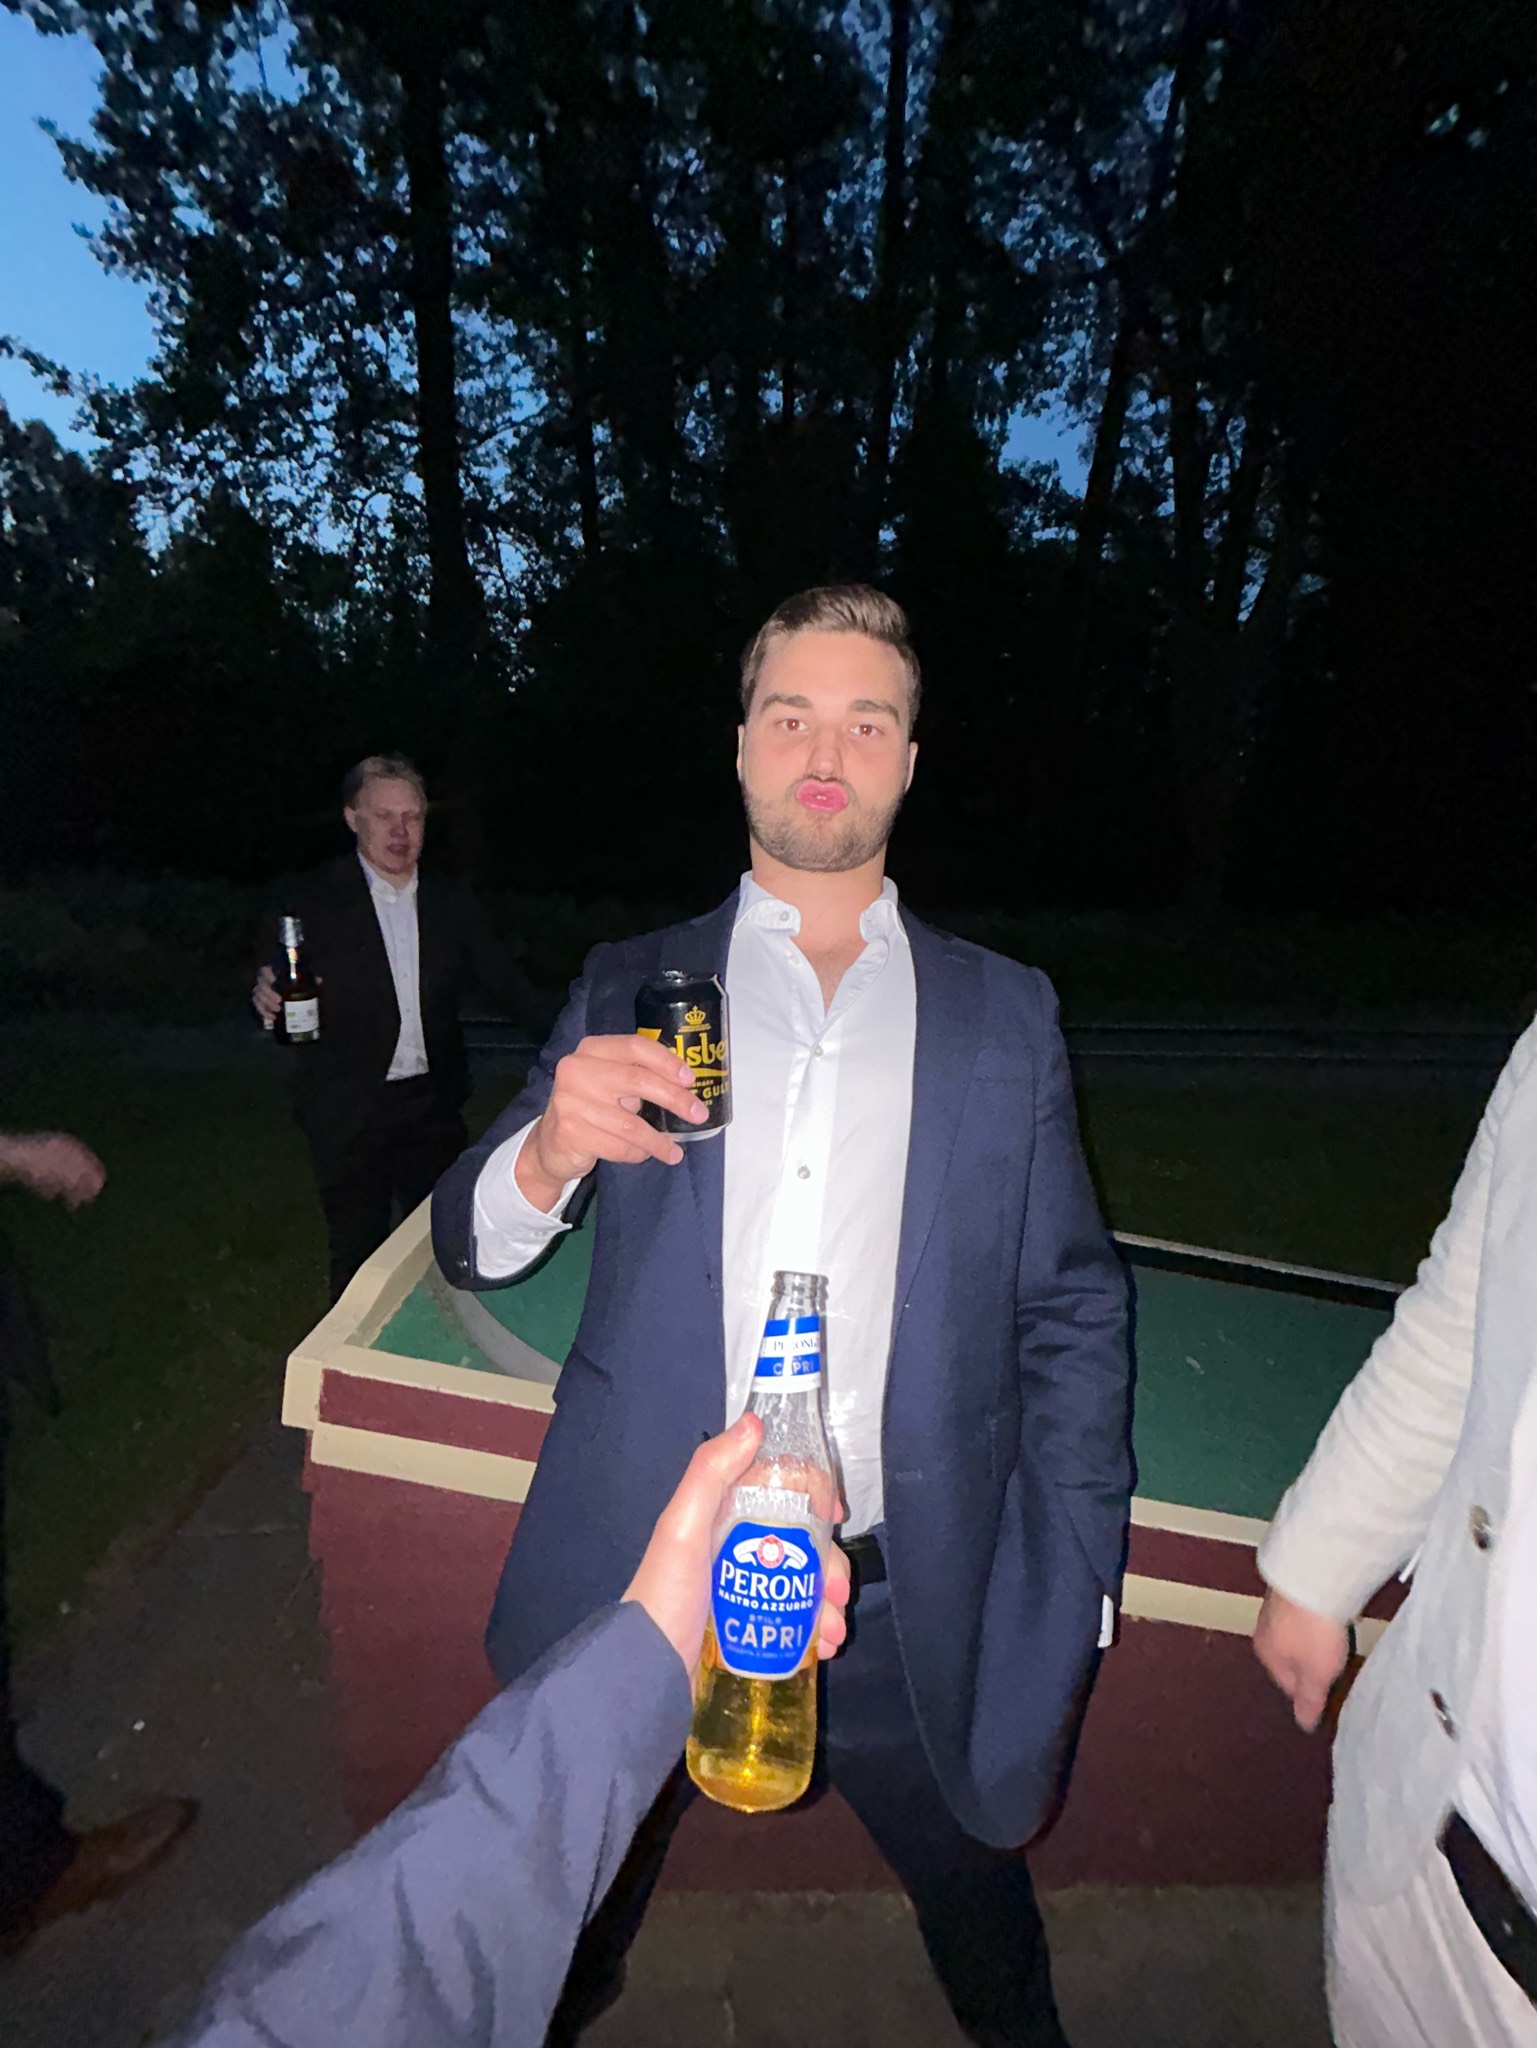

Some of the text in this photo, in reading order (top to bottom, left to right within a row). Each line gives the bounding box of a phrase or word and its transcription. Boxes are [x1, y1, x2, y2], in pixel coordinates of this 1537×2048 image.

[772, 1361, 815, 1376] CPRI
[720, 1559, 815, 1600] PERONI
[718, 1587, 813, 1612] NASTRO AZZURRO
[725, 1618, 803, 1649] CAPRI
